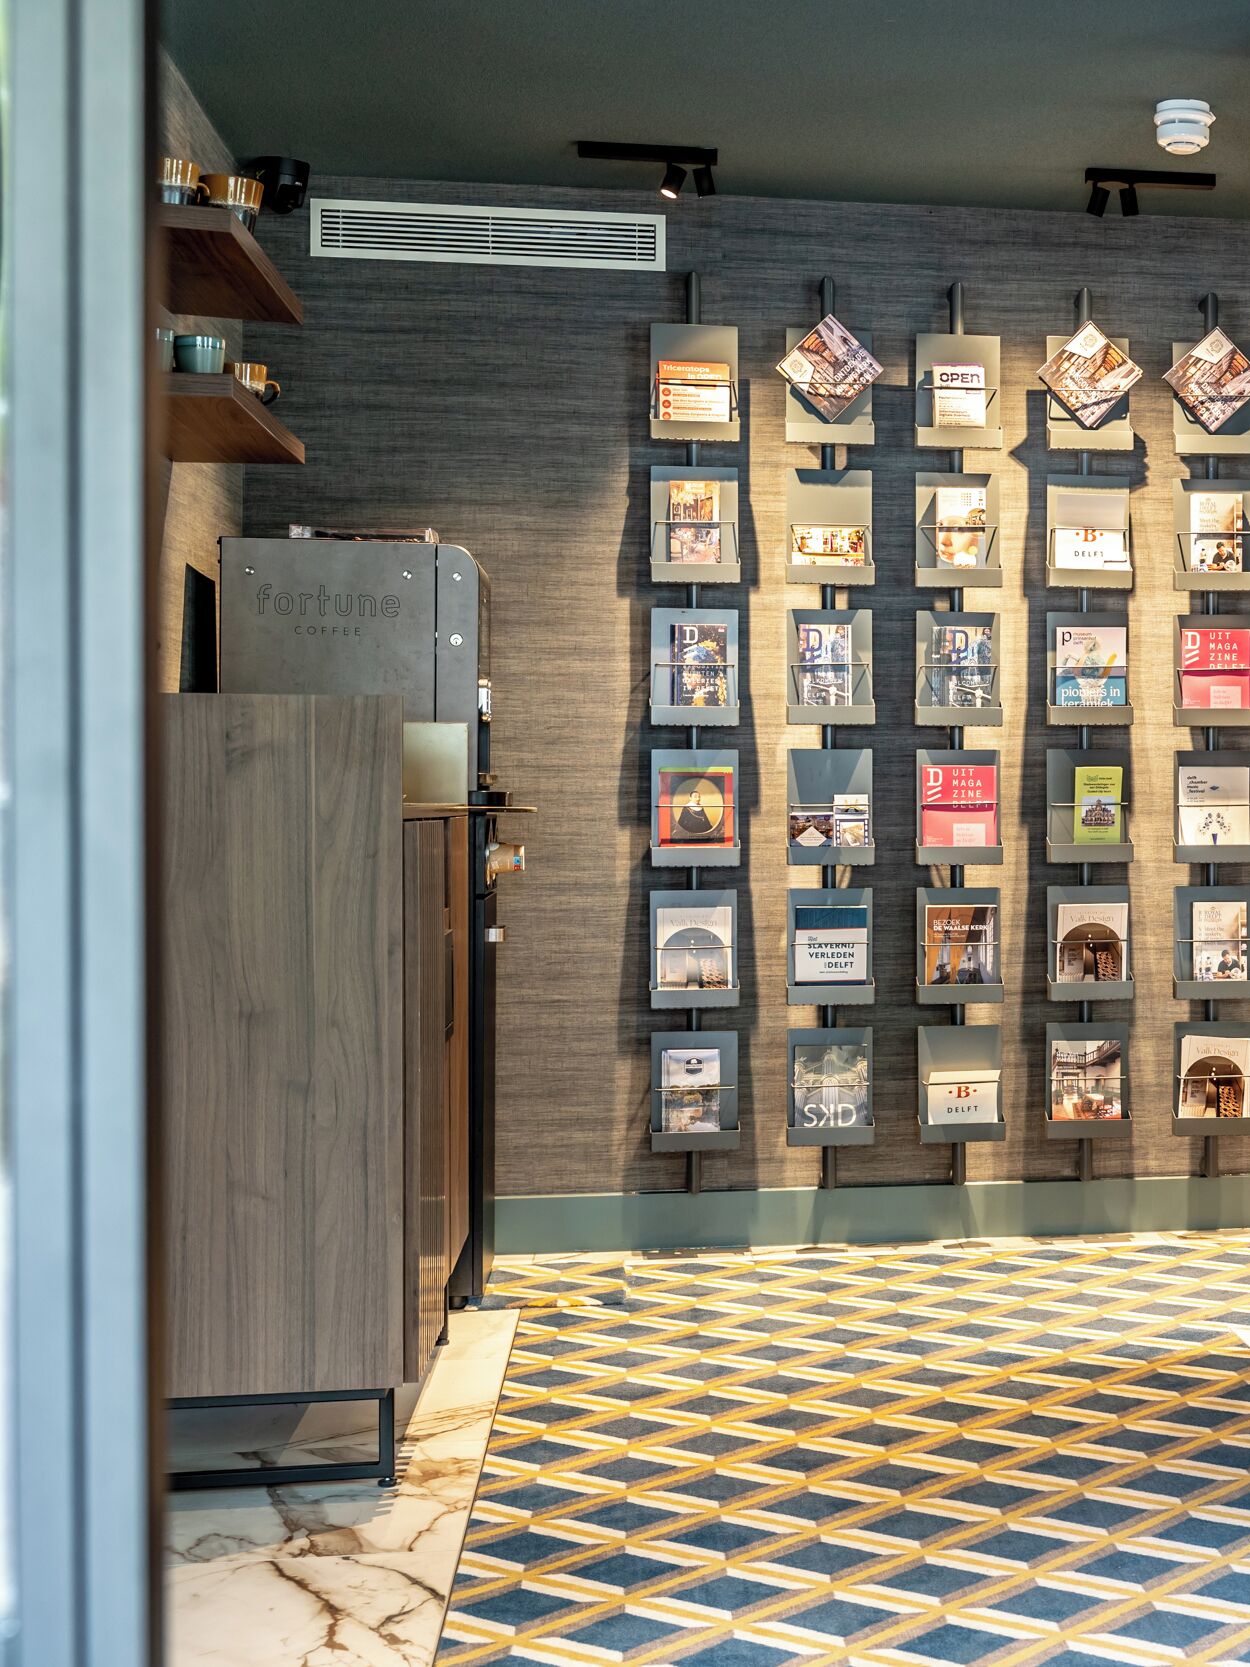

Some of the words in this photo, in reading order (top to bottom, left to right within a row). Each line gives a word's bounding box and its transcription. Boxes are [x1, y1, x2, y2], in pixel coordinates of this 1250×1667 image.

[663, 365, 710, 373] Triceratops
[257, 584, 400, 617] fortune
[294, 626, 361, 636] COFFEE
[683, 627, 698, 643] D
[1184, 632, 1200, 649] D
[1209, 632, 1231, 640] UIT
[1209, 653, 1238, 661] ZINE
[1110, 686, 1121, 697] in
[926, 768, 943, 786] D
[952, 768, 975, 776] UIT
[952, 779, 982, 787] MAGA
[952, 789, 982, 798] ZINE
[1213, 1048, 1239, 1057] Design
[955, 1085, 970, 1098] B
[947, 1105, 979, 1113] DELFT
